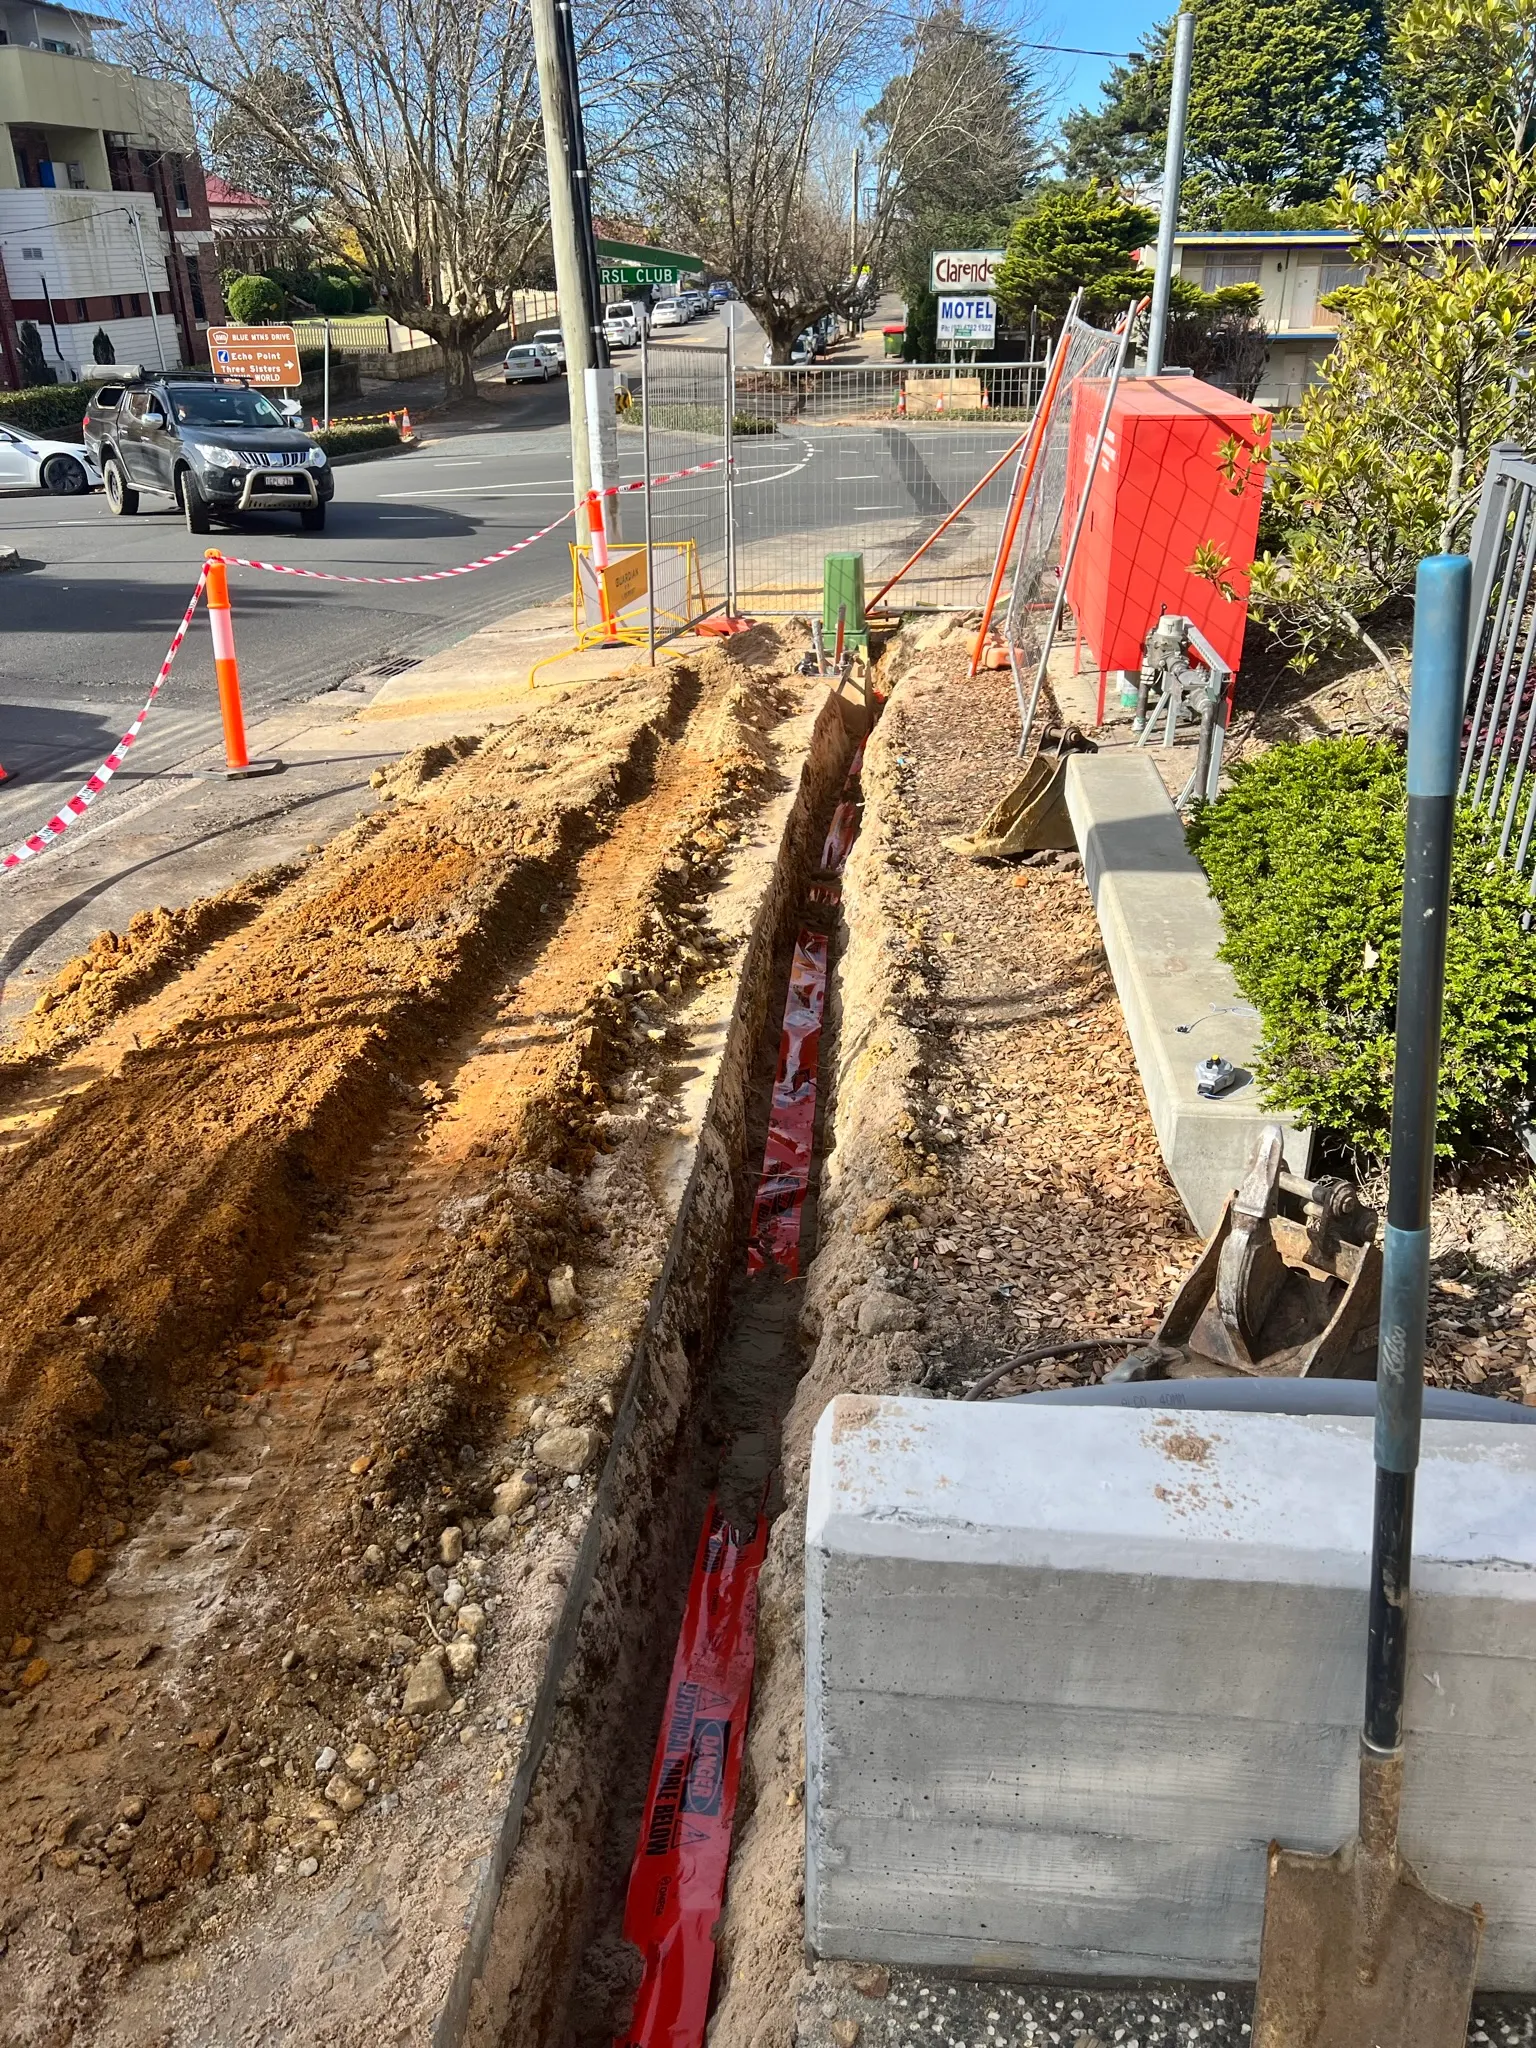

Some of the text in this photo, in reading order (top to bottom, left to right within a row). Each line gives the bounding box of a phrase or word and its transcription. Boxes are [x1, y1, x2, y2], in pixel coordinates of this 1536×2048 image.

[601, 268, 673, 283] RSL CLUB
[936, 257, 1001, 282] Clarendo
[941, 301, 993, 319] MOTEL
[232, 333, 291, 341] BLUE MTNS DRIVE
[231, 352, 281, 360] Echo Point
[220, 365, 282, 373] Three Sisters
[254, 374, 281, 382] WORLD
[666, 1681, 699, 1753] ELECTRICAL
[692, 1735, 720, 1798] DANGER
[646, 1804, 677, 1856] BELOW
